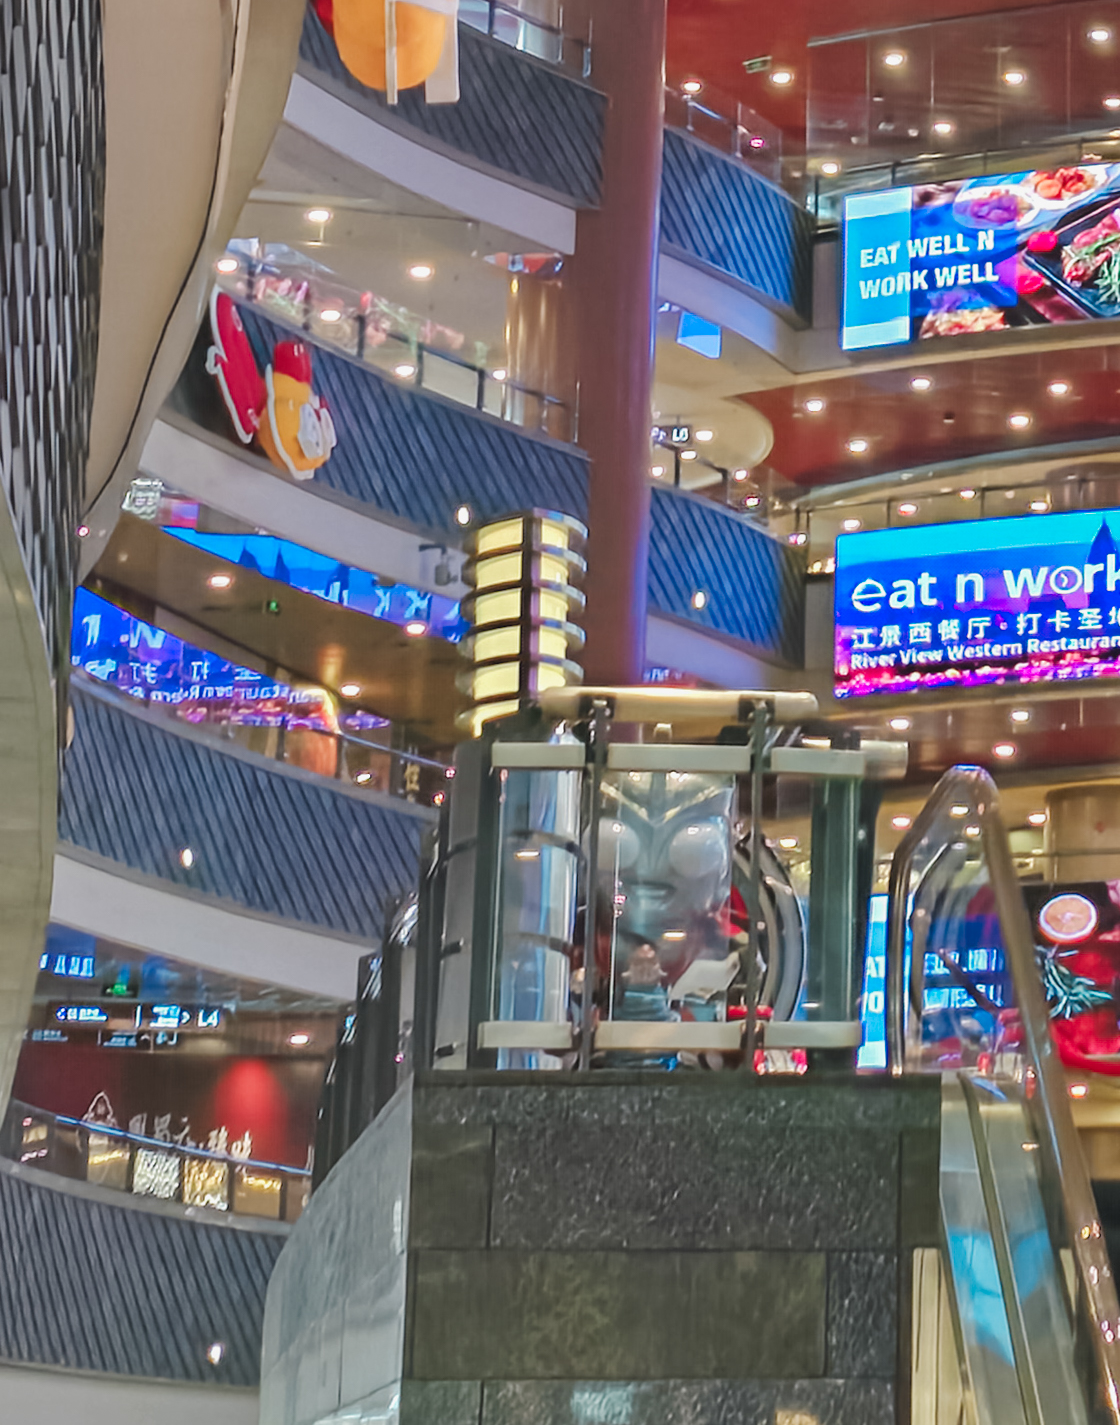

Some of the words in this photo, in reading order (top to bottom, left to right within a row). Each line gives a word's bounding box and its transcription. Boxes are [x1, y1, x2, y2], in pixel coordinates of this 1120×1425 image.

[860, 241, 901, 268] EAT
[906, 232, 970, 259] WELL
[977, 229, 995, 251] N
[858, 268, 929, 300] WORK
[934, 262, 999, 288] WELL
[851, 571, 938, 612] eat
[956, 571, 984, 604] n
[851, 653, 898, 670] River
[899, 648, 944, 665] View
[947, 643, 1022, 662] Western
